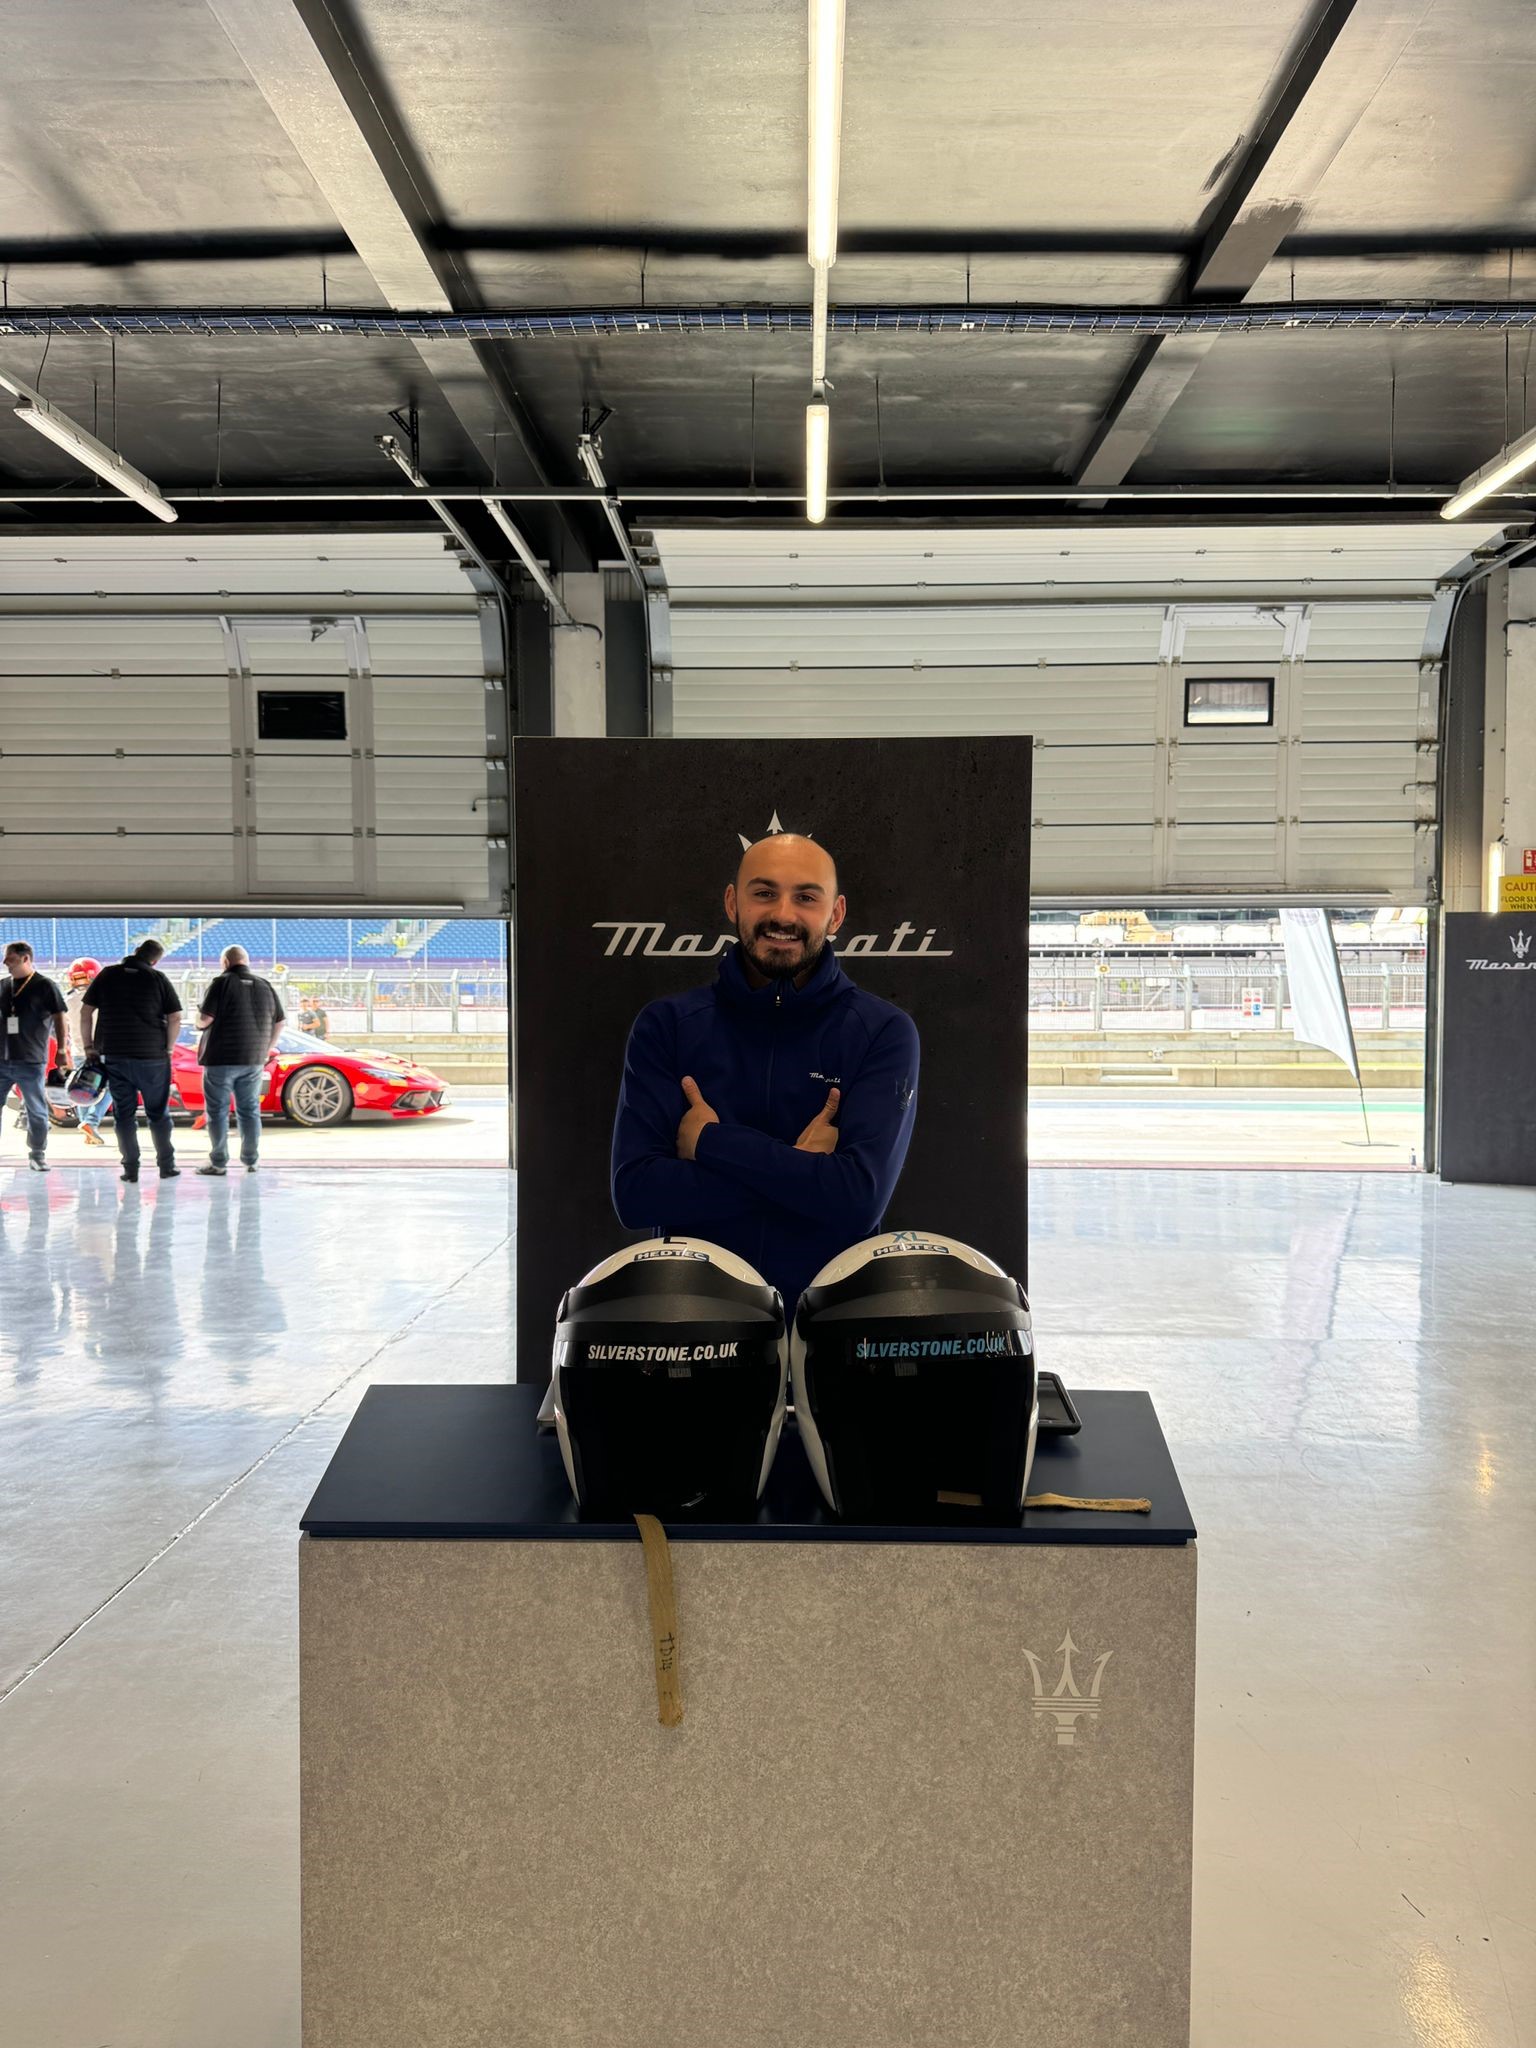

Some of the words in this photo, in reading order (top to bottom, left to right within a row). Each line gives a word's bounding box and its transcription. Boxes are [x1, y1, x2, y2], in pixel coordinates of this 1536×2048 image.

[891, 1231, 929, 1244] XL
[588, 1342, 738, 1362] SILVERSTONE.CO.UK
[855, 1336, 1006, 1358] SILVERSTONE.CO.UK
